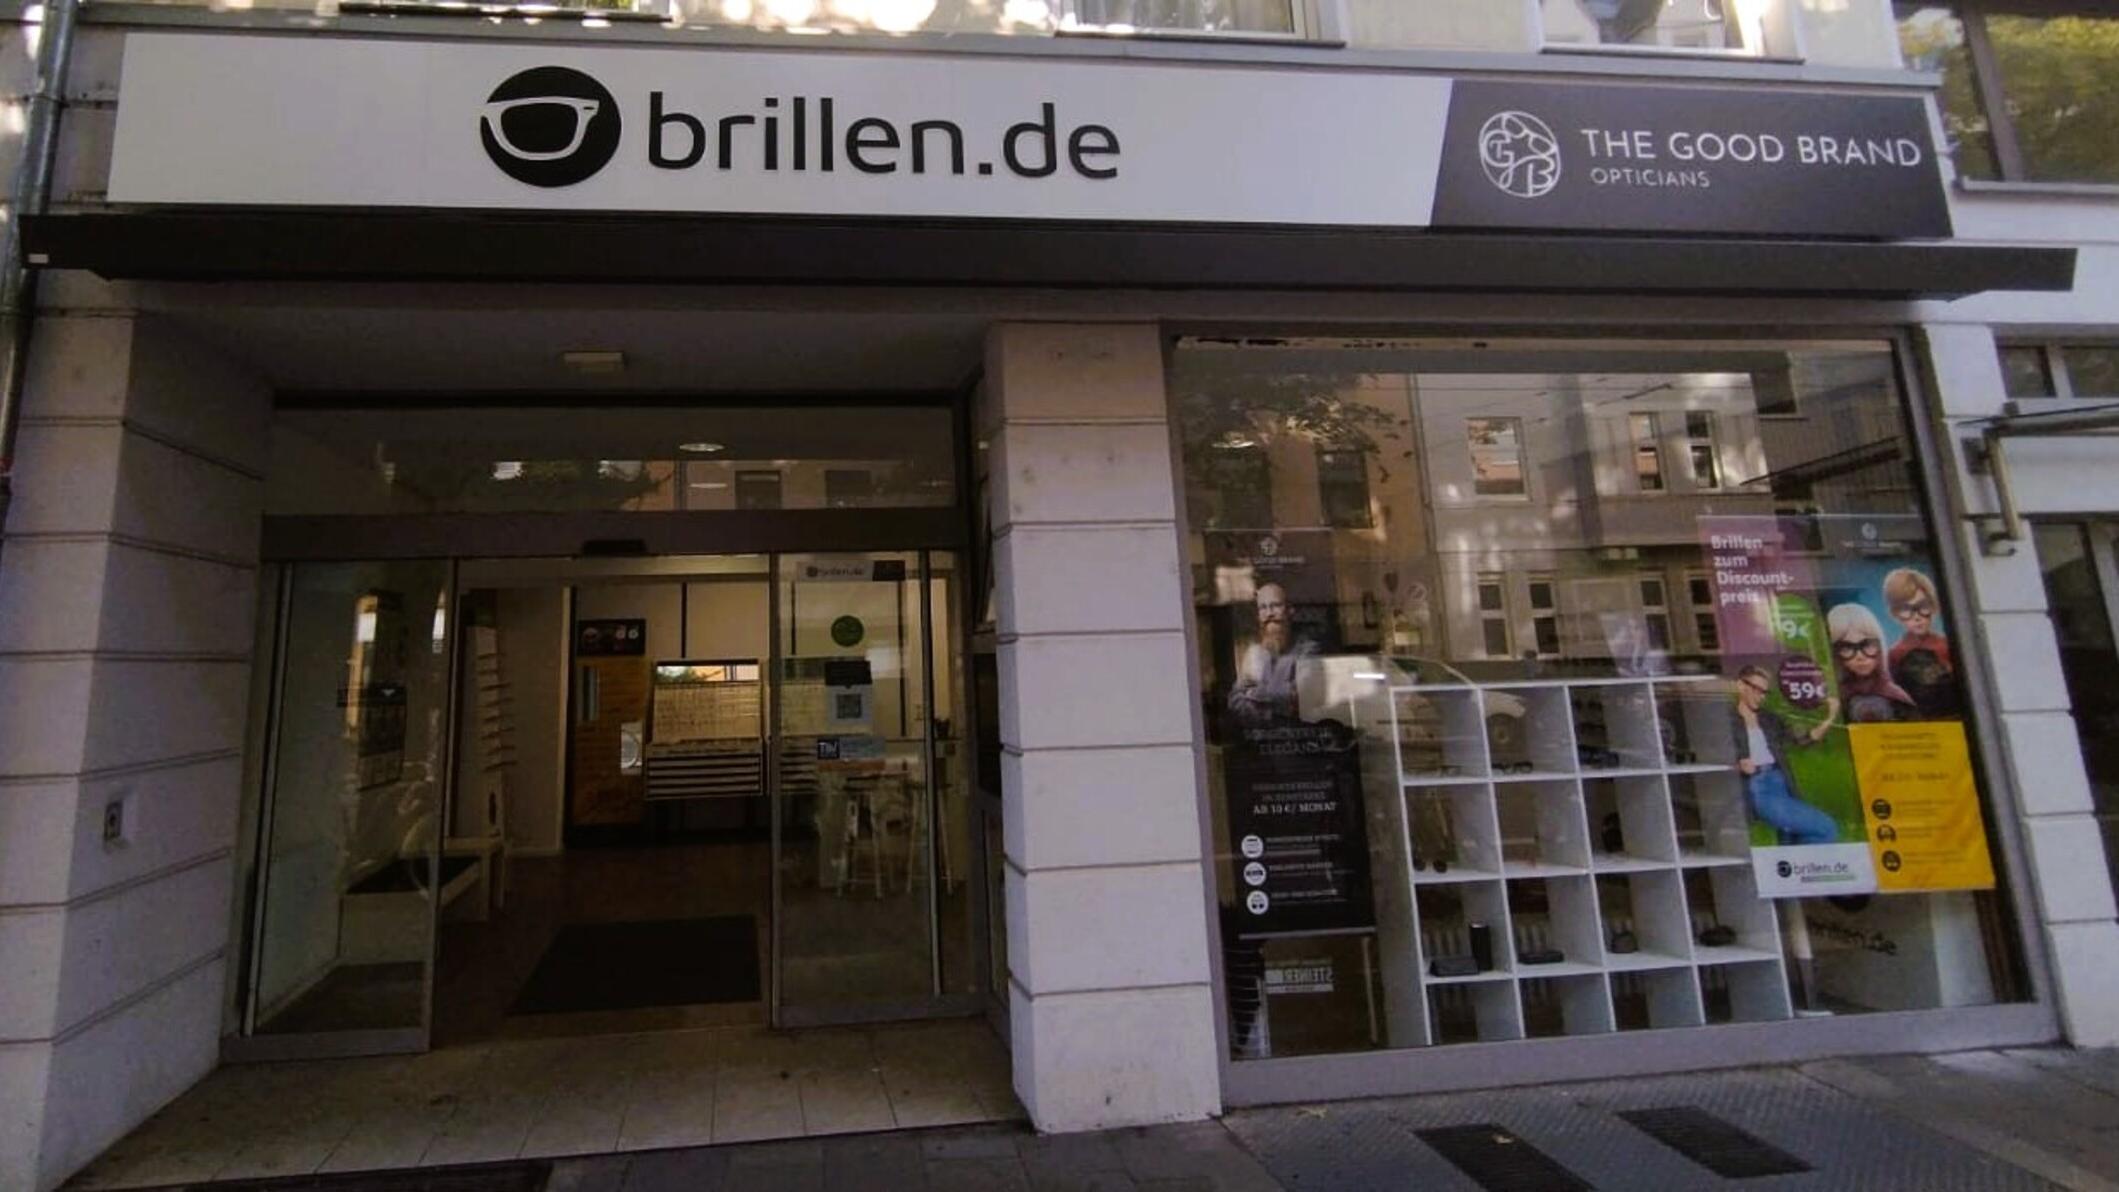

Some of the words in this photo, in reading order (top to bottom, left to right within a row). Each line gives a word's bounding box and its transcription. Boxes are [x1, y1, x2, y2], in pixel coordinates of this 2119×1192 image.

[648, 91, 1121, 179] brillen.de
[1581, 129, 1656, 159] THE
[1669, 131, 1784, 162] GOOD
[1800, 136, 1922, 168] BRAND
[1590, 167, 1711, 189] OPTICIANS
[1711, 535, 1763, 550] Brillen
[1714, 555, 1749, 568] zum
[1716, 570, 1795, 586] Discount-
[1793, 861, 1849, 875] brillen.de
